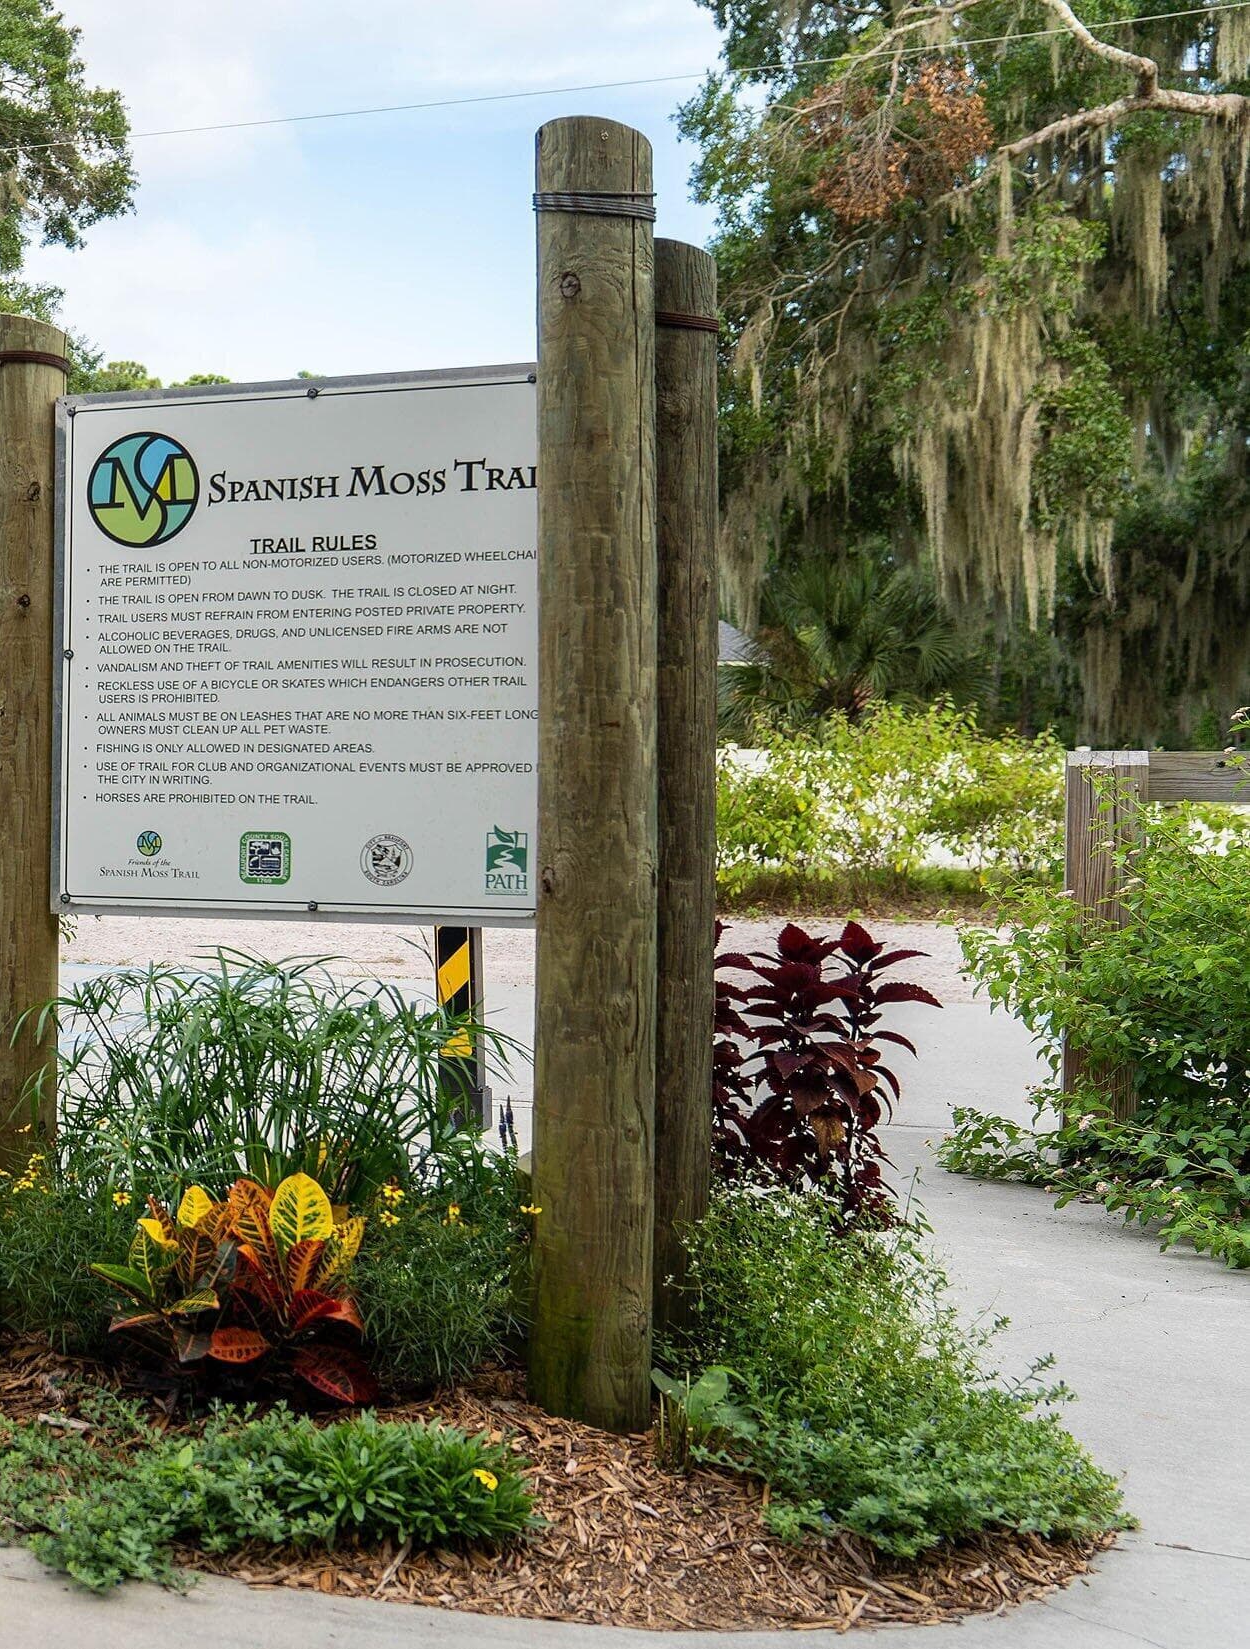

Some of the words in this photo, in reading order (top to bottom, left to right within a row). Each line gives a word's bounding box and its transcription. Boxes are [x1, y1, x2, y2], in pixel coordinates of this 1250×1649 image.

[207, 471, 339, 506] SPANISH
[346, 465, 447, 498] MOSS
[453, 457, 537, 493] TRAI
[250, 538, 306, 554] TRAIL
[311, 535, 377, 551] RULES
[98, 564, 120, 574] THE
[122, 563, 153, 573] TRAIL
[155, 562, 166, 572] IS
[168, 562, 200, 572] OPEN
[201, 561, 217, 571] TO
[219, 560, 240, 570] ALL
[242, 557, 339, 569] NON-MOTORIZED
[342, 555, 384, 566] USERS.
[387, 552, 462, 566] (MOTORIZED
[100, 577, 122, 587] ARE
[125, 575, 191, 586] PERMITTED)
[98, 595, 119, 605] THE
[121, 595, 152, 604] TRAIL
[155, 594, 165, 604] IS
[168, 593, 199, 604] OPEN
[202, 592, 234, 602] FROM
[237, 591, 271, 601] DAWN
[273, 590, 289, 600] TO
[291, 589, 326, 600] DUSK.
[331, 588, 354, 599] THE
[357, 588, 390, 598] TRAIL
[394, 587, 405, 597] IS
[408, 585, 457, 597] CLOSED
[459, 585, 474, 595] AT
[477, 584, 517, 595] NIGHT.
[97, 614, 128, 623] TRAIL
[131, 612, 168, 623] USERS
[171, 611, 202, 622] MUST
[205, 610, 254, 621] REFRAIN
[256, 609, 290, 619] FROM
[293, 607, 352, 619] ENTERING
[355, 606, 403, 617] POSTED
[406, 605, 455, 616] PRIVATE
[458, 603, 526, 614] PROPERTY.
[97, 631, 160, 642] ALCOHOLIC
[163, 629, 233, 640] BEVERAGES,
[236, 628, 278, 639] DRUGS,
[281, 627, 306, 638] AND
[309, 626, 384, 637] UNLICENSED
[387, 625, 413, 636] FIRE
[416, 624, 451, 635] ARMS
[454, 624, 479, 634] ARE
[483, 623, 508, 634] NOT
[99, 644, 152, 655] ALLOWED
[154, 644, 171, 654] ON
[173, 643, 195, 653] THE
[197, 643, 231, 652] TRAIL.
[97, 662, 157, 673] VANDALISM
[160, 662, 184, 672] AND
[186, 661, 221, 671] THEFT
[224, 661, 240, 671] OF
[242, 661, 274, 670] TRAIL
[276, 659, 339, 670] AMENITIES
[341, 659, 368, 669] WILL
[371, 658, 417, 668] RESULT
[420, 658, 432, 668] IN
[435, 656, 526, 668] PROSECUTION.
[97, 681, 154, 691] RECKLESS
[157, 680, 179, 690] USE
[182, 680, 198, 690] OF
[200, 680, 208, 689] A
[211, 679, 258, 690] BICYCLE
[261, 679, 279, 689] OR
[281, 678, 325, 689] SKATES
[327, 678, 367, 688] WHICH
[370, 677, 445, 688] ENDANGERS
[448, 676, 490, 687] OTHER
[492, 676, 527, 686] TRAIL
[99, 694, 136, 704] USERS
[138, 693, 149, 704] IS
[151, 693, 220, 703] PROHIBITED.
[96, 713, 116, 722] ALL
[118, 712, 166, 722] ANIMALS
[169, 712, 200, 722] MUST
[203, 712, 217, 721] BE
[220, 711, 237, 721] ON
[240, 711, 292, 721] LEASHES
[294, 711, 323, 721] THAT
[325, 711, 350, 721] ARE
[353, 710, 371, 721] NO
[373, 710, 409, 720] MORE
[411, 710, 444, 720] THAN
[447, 710, 502, 720] SIX-FEET
[98, 725, 146, 735] OWNERS
[149, 725, 180, 735] MUST
[182, 725, 220, 735] CLEAN
[222, 724, 238, 735] UP
[240, 725, 261, 734] ALL
[264, 724, 286, 734] PET
[288, 724, 331, 734] WASTE.
[96, 743, 140, 753] FISHING
[142, 743, 153, 753] IS
[155, 743, 184, 753] ONLY
[186, 743, 241, 753] ALLOWED
[243, 744, 255, 753] IN
[258, 743, 330, 753] DESIGNATED
[332, 743, 375, 753] AREAS.
[96, 762, 118, 771] USE
[120, 762, 136, 772] OF
[138, 762, 169, 771] TRAIL
[172, 762, 195, 772] FOR
[197, 762, 227, 773] CLUB
[229, 762, 254, 772] AND
[256, 762, 356, 772] ORGANIZATIONAL
[359, 762, 406, 773] EVENTS
[409, 762, 443, 773] MUST
[446, 762, 462, 773] BE
[465, 763, 533, 773] APPROVED
[97, 774, 119, 784] THE
[121, 775, 146, 784] CITY
[149, 775, 160, 784] IN
[162, 775, 212, 785] WRITING.
[95, 793, 141, 803] HORSES
[143, 793, 166, 803] ARE
[168, 793, 236, 804] PROHIBITED
[238, 794, 255, 804] ON
[258, 794, 280, 804] THE
[283, 794, 318, 804] TRAIL.
[128, 858, 151, 866] Friends
[152, 858, 160, 868] of
[161, 858, 171, 866] the
[99, 867, 138, 877] SPANISH
[141, 868, 169, 878] MOSS
[171, 868, 200, 879] TRAIL
[484, 873, 528, 890] PATH
